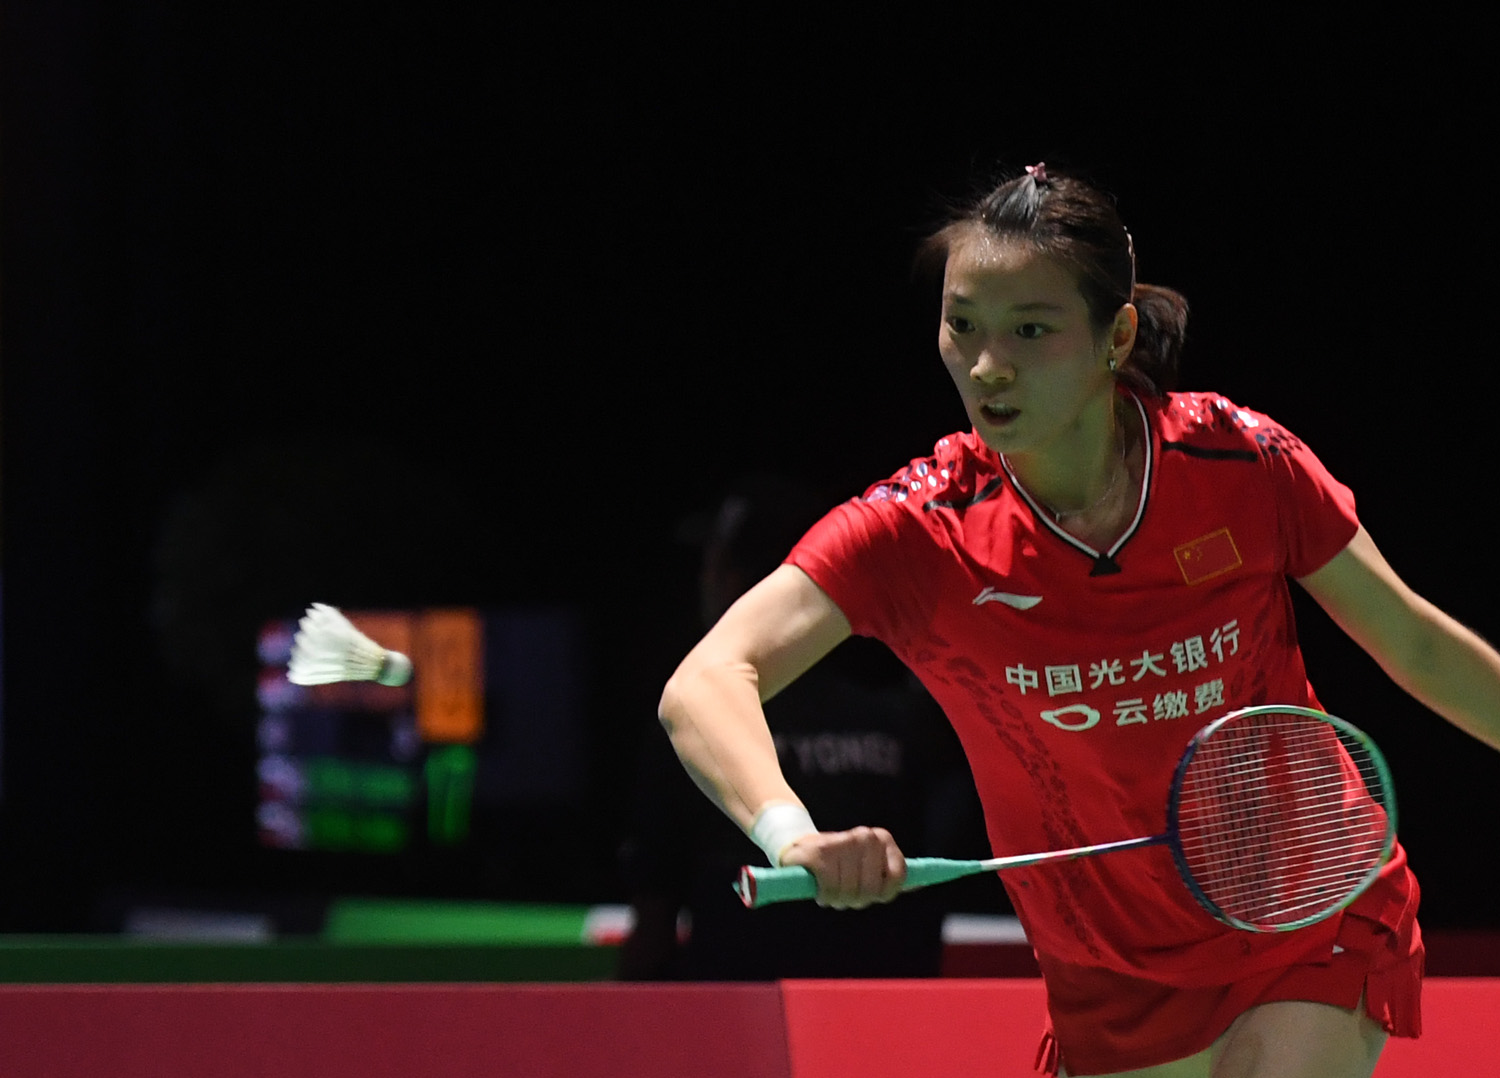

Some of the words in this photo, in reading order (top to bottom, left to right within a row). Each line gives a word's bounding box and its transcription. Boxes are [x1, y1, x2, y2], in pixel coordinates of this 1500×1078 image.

[1006, 620, 1240, 696] 中国光大银行
[1113, 679, 1225, 727] 云缴费
